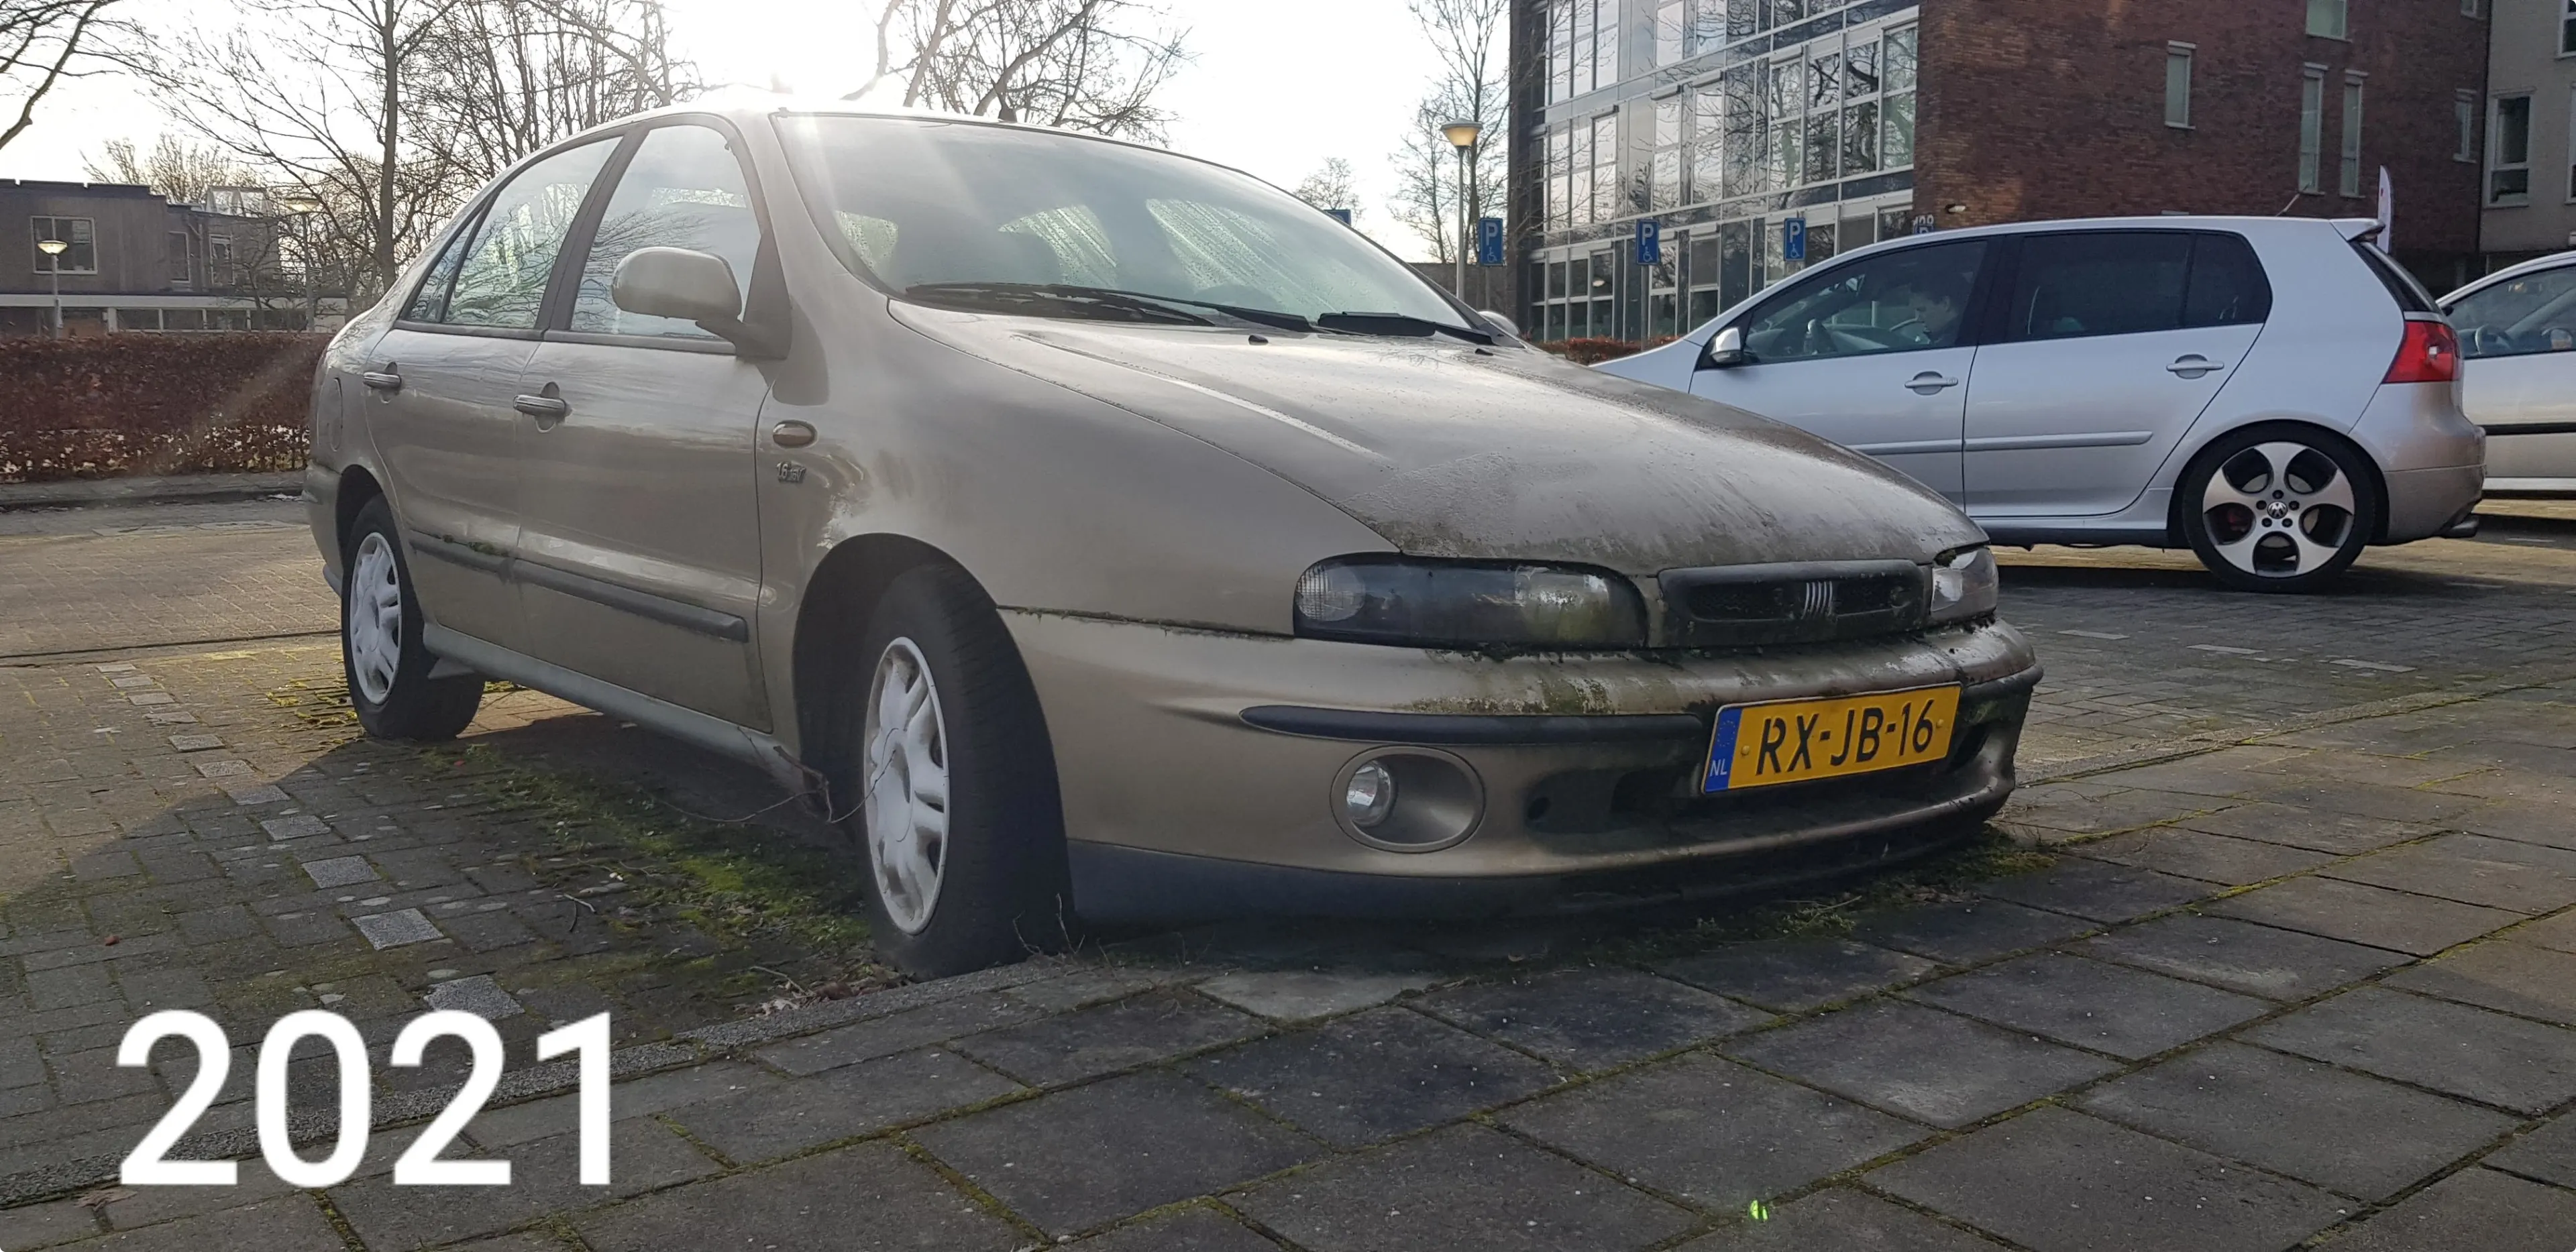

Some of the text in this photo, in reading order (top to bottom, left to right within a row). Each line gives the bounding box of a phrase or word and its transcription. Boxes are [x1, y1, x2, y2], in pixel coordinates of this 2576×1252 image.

[1485, 222, 1499, 245] P
[1642, 223, 1654, 245] P
[1790, 222, 1801, 243] P
[1756, 699, 1933, 775] RX-JB-16
[1709, 759, 1727, 777] NL
